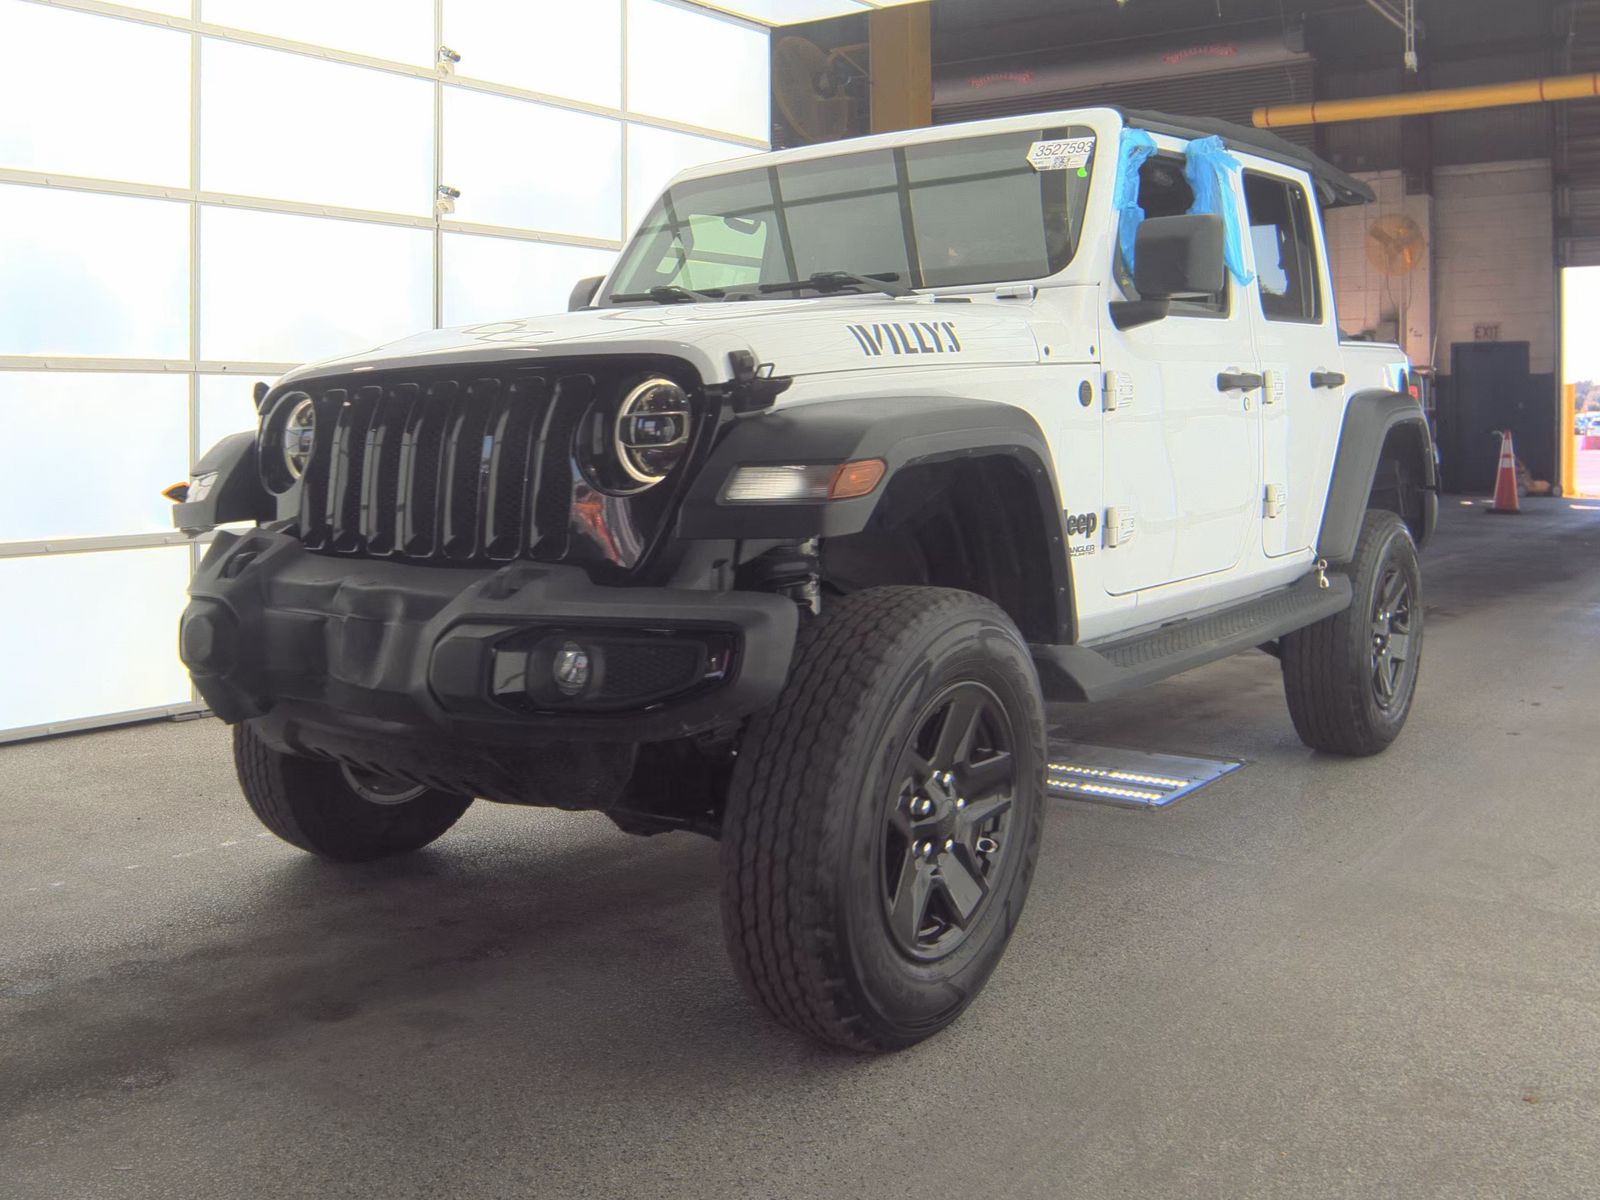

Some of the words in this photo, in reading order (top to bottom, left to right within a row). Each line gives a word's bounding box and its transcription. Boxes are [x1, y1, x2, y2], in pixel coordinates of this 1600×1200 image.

[1035, 141, 1093, 157] 3527593
[846, 322, 961, 356] WILLYS
[1474, 326, 1499, 340] EXIT
[1068, 544, 1095, 554] NGLER
